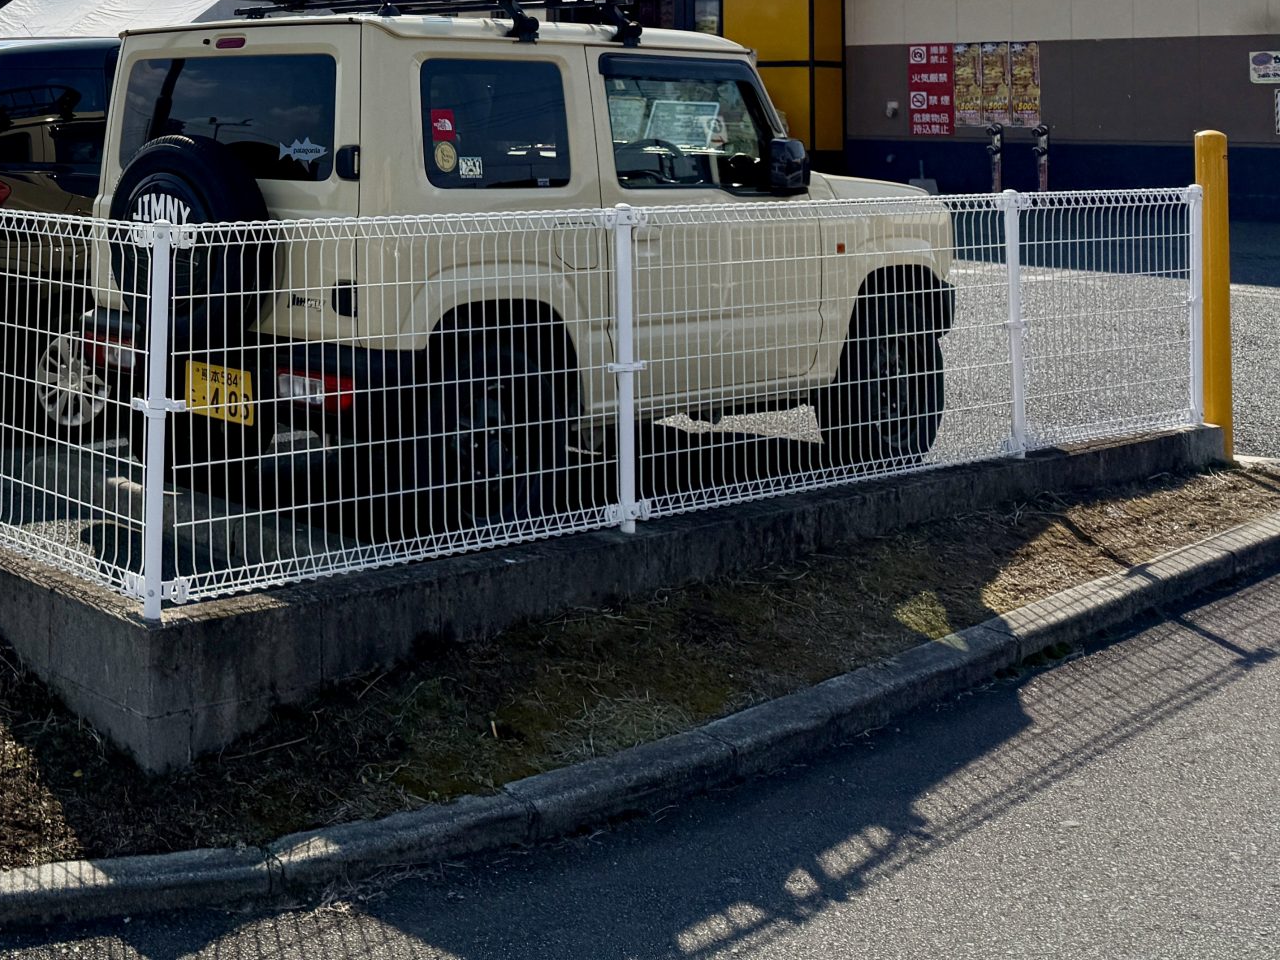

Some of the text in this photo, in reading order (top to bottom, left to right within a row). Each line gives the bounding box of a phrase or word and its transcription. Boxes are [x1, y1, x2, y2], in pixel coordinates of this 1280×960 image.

[911, 73, 948, 83] 火気厳禁
[913, 124, 950, 135] 持込禁止
[133, 193, 191, 225] JIMNY
